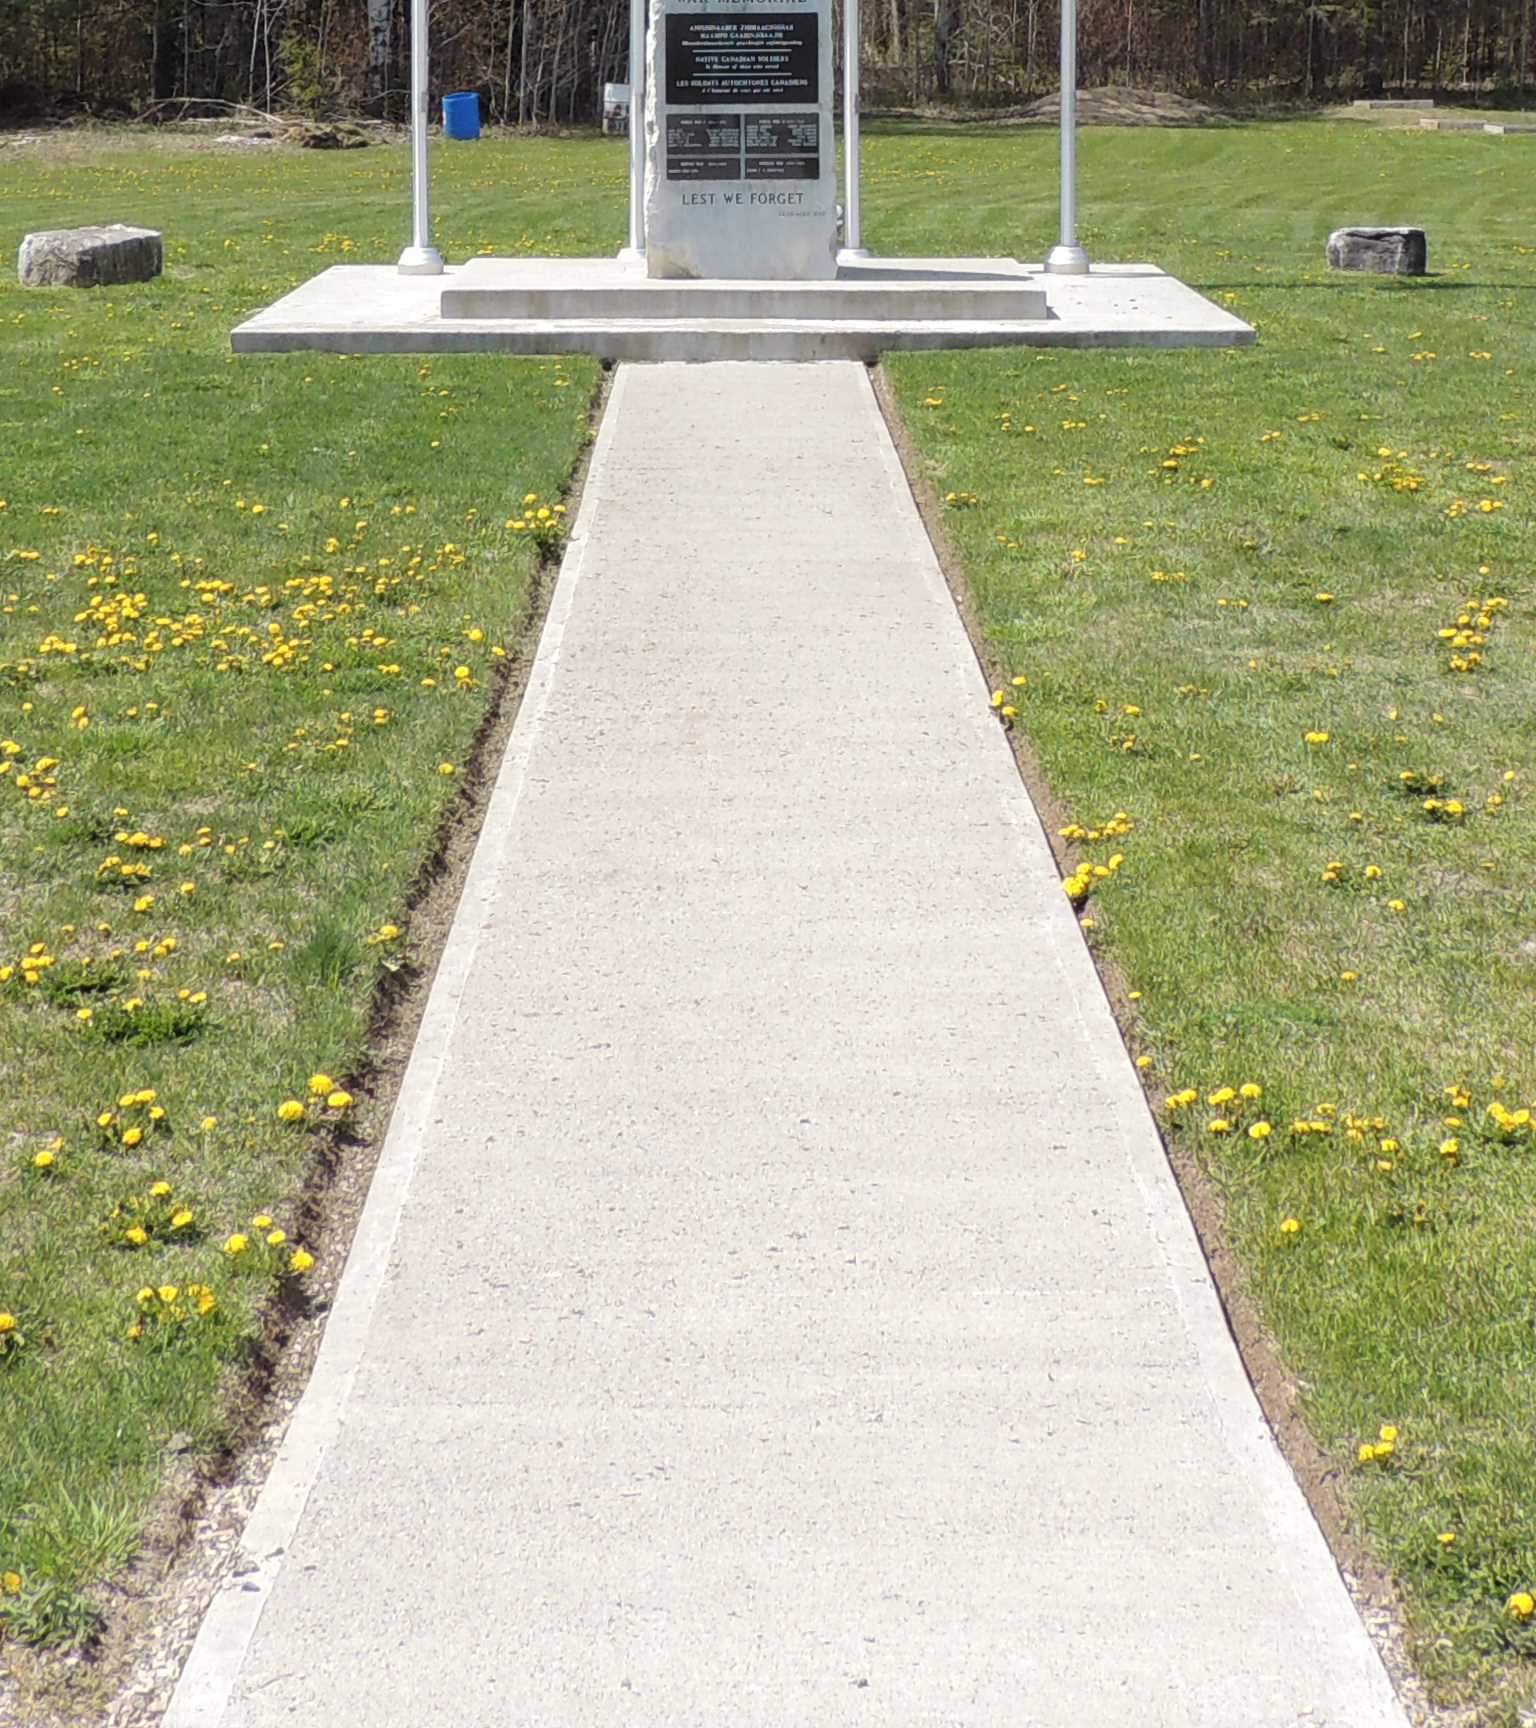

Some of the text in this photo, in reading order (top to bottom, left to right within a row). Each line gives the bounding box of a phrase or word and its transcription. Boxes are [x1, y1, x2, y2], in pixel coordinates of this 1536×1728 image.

[682, 192, 804, 205] LEST WE FORGET
